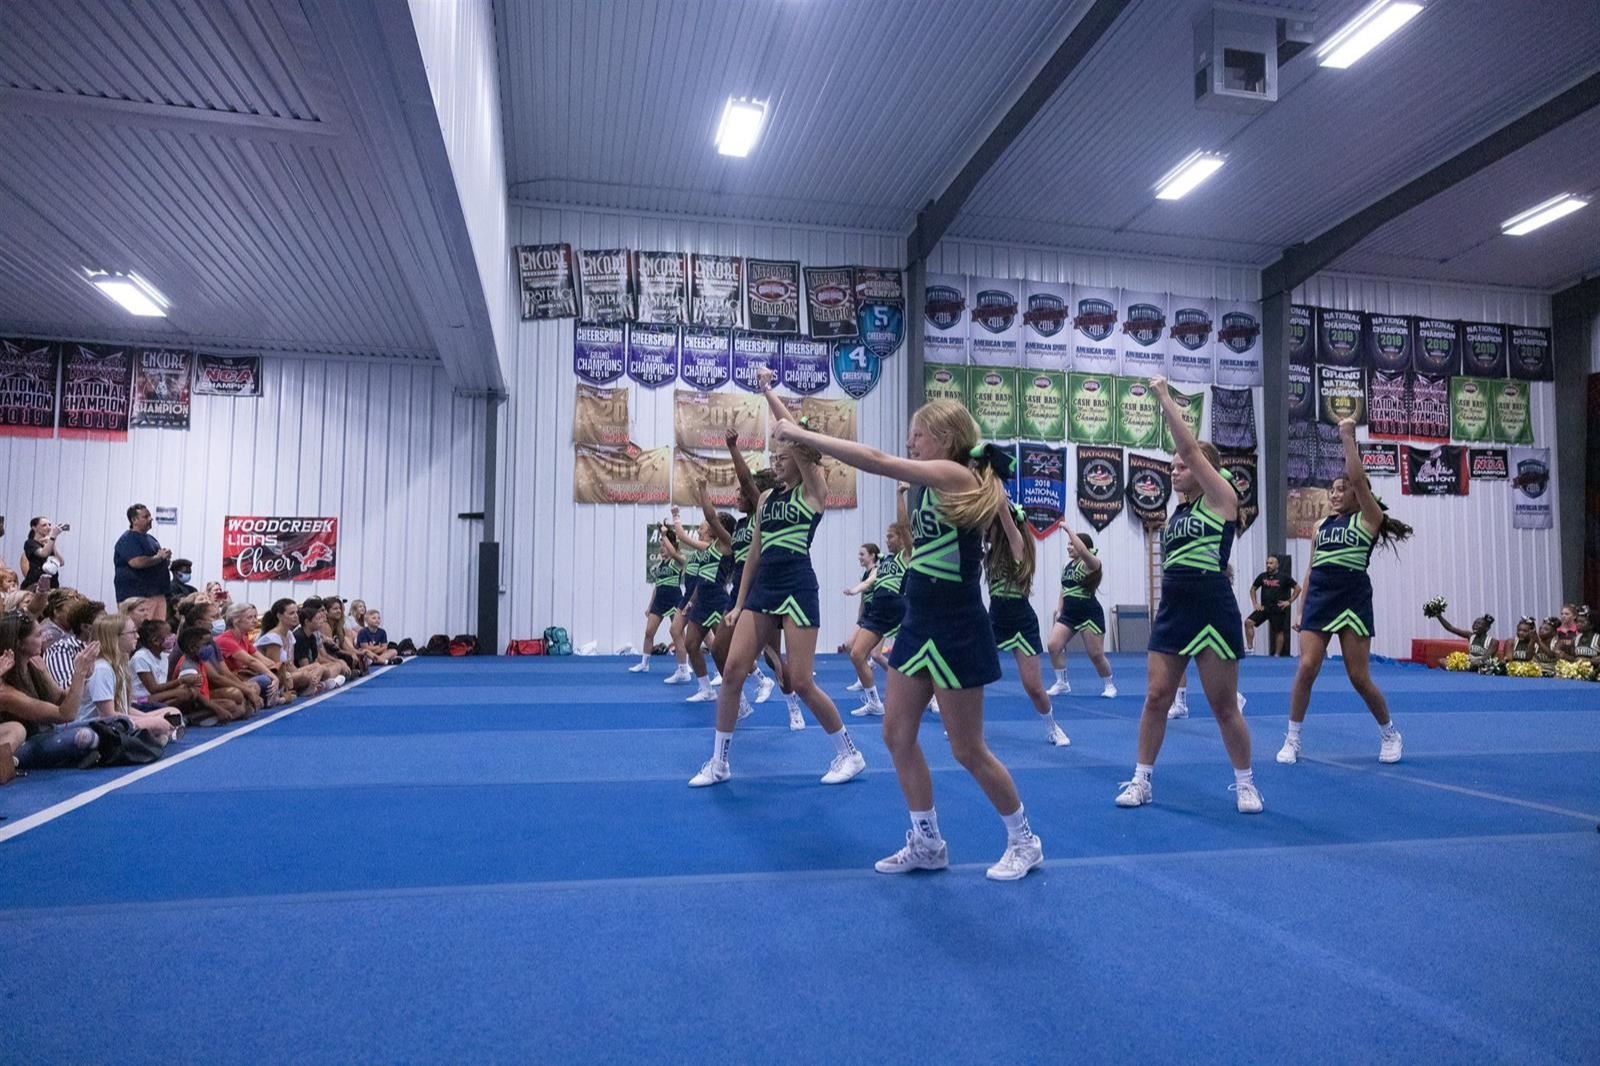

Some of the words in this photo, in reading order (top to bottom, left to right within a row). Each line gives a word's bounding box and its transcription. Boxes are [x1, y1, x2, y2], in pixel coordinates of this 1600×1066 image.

[520, 250, 568, 270] ENCORE
[583, 255, 627, 274] ENCORE
[639, 258, 683, 276] ENCORE
[752, 265, 792, 279] NATIONAL
[752, 300, 794, 315] CHAMPION
[873, 306, 888, 326] 5
[1323, 312, 1360, 323] NATIONAL
[1323, 321, 1361, 331] CHAMPION
[1372, 317, 1408, 327] NATIONAL
[1419, 320, 1455, 331] NATIONAL
[577, 329, 622, 342] CHEERSPORT
[1331, 330, 1354, 341] 2018
[1372, 326, 1408, 335] CHAMPION
[1419, 329, 1456, 340] CHAMPION
[1466, 325, 1500, 335] NATIONAL
[1513, 330, 1546, 339] NATIONAL
[631, 332, 676, 346] CHEERSPORT
[867, 332, 896, 341] CHEERSPORT
[1380, 335, 1402, 346] 2018
[1466, 334, 1502, 343] CHAMPION
[684, 337, 728, 349] CHEERSPORT
[734, 340, 778, 353] CHEERSPORT
[974, 339, 1000, 347] AMERICAN
[1025, 342, 1051, 350] AMERICAN
[1426, 339, 1449, 350] 2018
[1513, 338, 1547, 347] CHAMPION
[784, 343, 828, 355] CHEERSPORT
[1076, 346, 1101, 354] AMERICAN
[141, 351, 186, 369] ENCORE
[590, 351, 609, 360] GRAND
[643, 355, 662, 363] GRAND
[849, 346, 867, 367] 4
[1125, 351, 1150, 359] AMERICAN
[1173, 355, 1196, 363] AMERICAN
[577, 358, 622, 372] CHAMPIONS
[697, 358, 716, 366] GRAND
[631, 361, 675, 375] CHAMPIONS
[684, 365, 727, 379] CHAMPIONS
[1321, 368, 1361, 379] GRAND
[203, 368, 253, 382] NCA
[785, 370, 827, 383] CHAMPIONS
[842, 372, 872, 381] CHEERSPORT
[0, 378, 51, 395] ATIONAL
[65, 381, 125, 399] NATIONAL
[201, 381, 255, 389] CHAMPION
[1323, 380, 1359, 389] NATIONAL
[924, 390, 941, 398] CASH
[1321, 388, 1364, 397] CHAMPION
[1024, 395, 1041, 403] CASH
[1073, 399, 1091, 407] CASH
[63, 396, 127, 415] CHAMPION
[132, 403, 189, 414] CHAMPION
[601, 401, 628, 421] 20
[1121, 402, 1137, 411] CASH
[701, 406, 747, 427] 2017
[977, 408, 1010, 417] Champion
[1026, 410, 1059, 419] Champion
[1075, 413, 1107, 422] Champion
[68, 411, 119, 428] 2019
[1123, 416, 1153, 426] Champion
[1080, 450, 1121, 461] NATIONAL
[1362, 455, 1395, 465] NCA
[1130, 459, 1171, 475] NATIONAL
[1473, 459, 1506, 470] NCA
[1025, 488, 1060, 499] NATIONAL
[1024, 496, 1060, 508] CHAMPION
[1079, 499, 1122, 510] CHAMPIONS
[760, 501, 800, 524] LMS
[228, 519, 333, 533] WOODCREEK
[911, 509, 941, 538] MS
[1164, 516, 1205, 546] LMS
[228, 534, 278, 546] LIONS
[231, 546, 294, 577] Cheer
